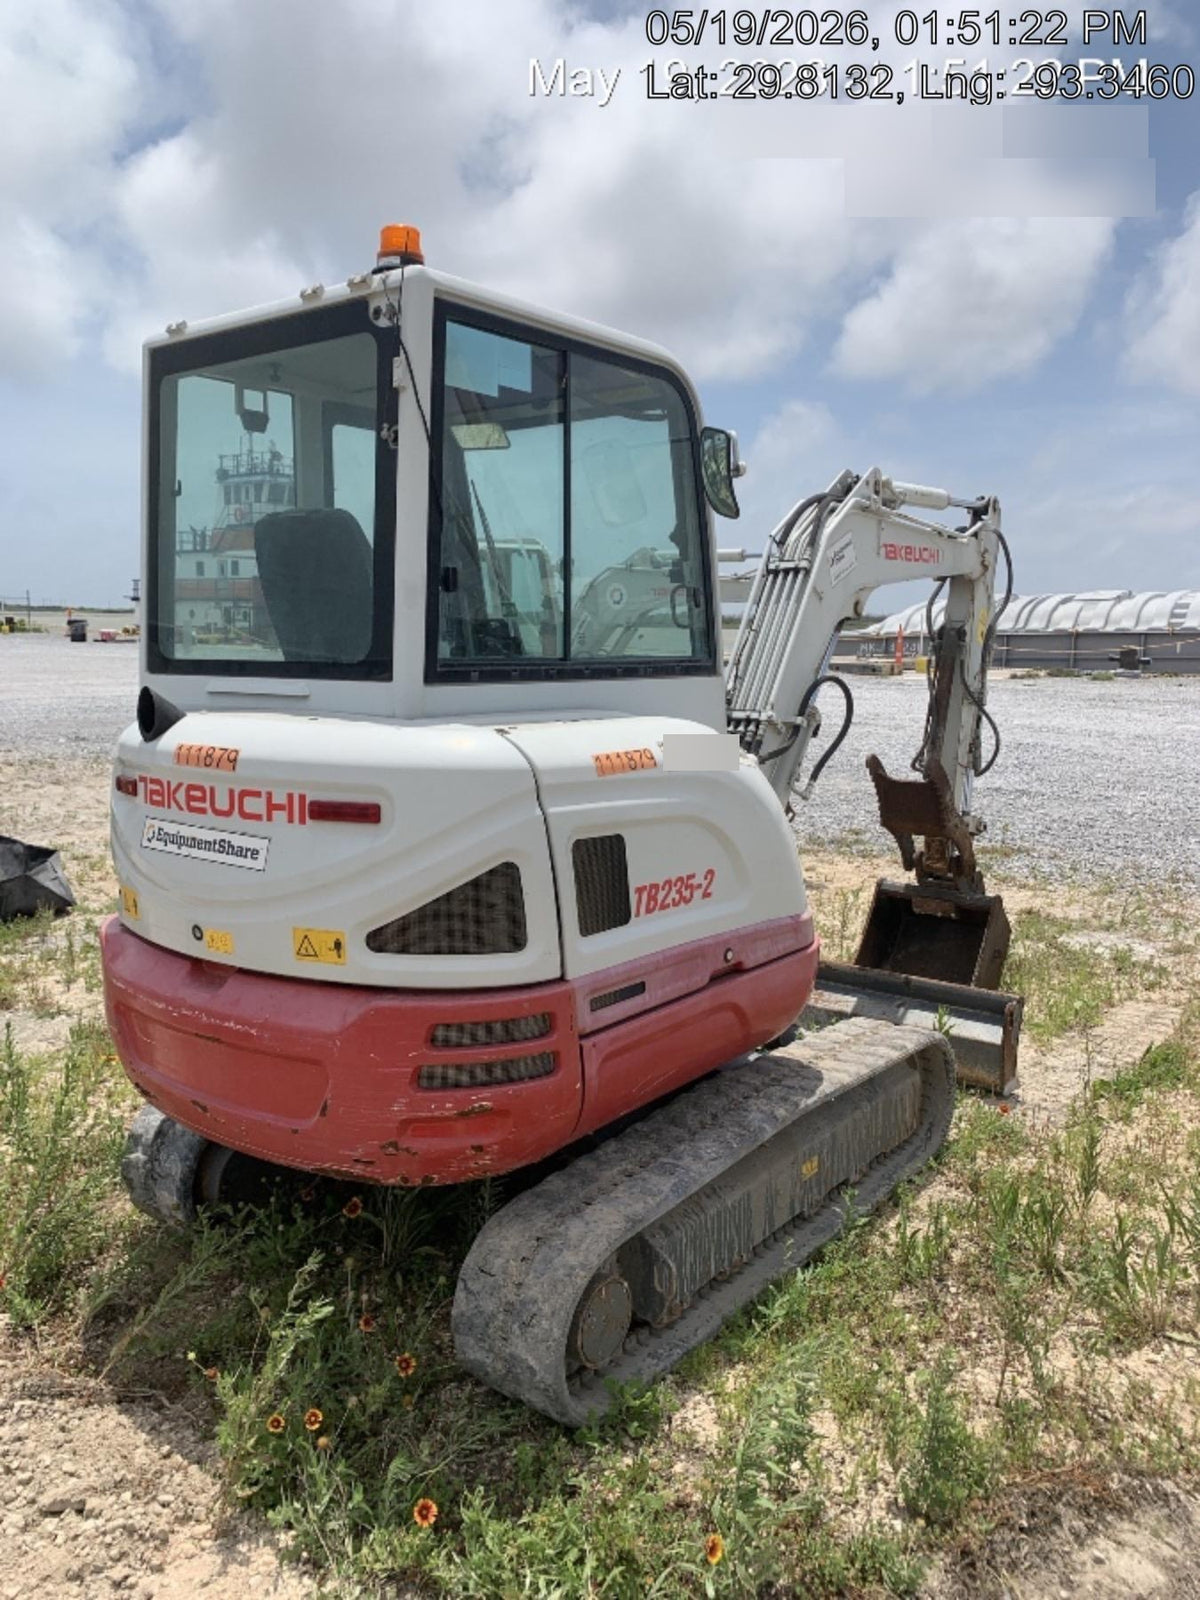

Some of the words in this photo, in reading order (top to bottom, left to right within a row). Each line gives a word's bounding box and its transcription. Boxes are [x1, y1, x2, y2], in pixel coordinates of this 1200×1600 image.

[882, 543, 940, 564] TAKEUCHI
[176, 744, 240, 772] 111879
[594, 748, 658, 776] 111879
[138, 775, 307, 826] TAKEUCHI
[155, 827, 260, 861] EquipmentShare
[634, 868, 716, 918] TB235-2
